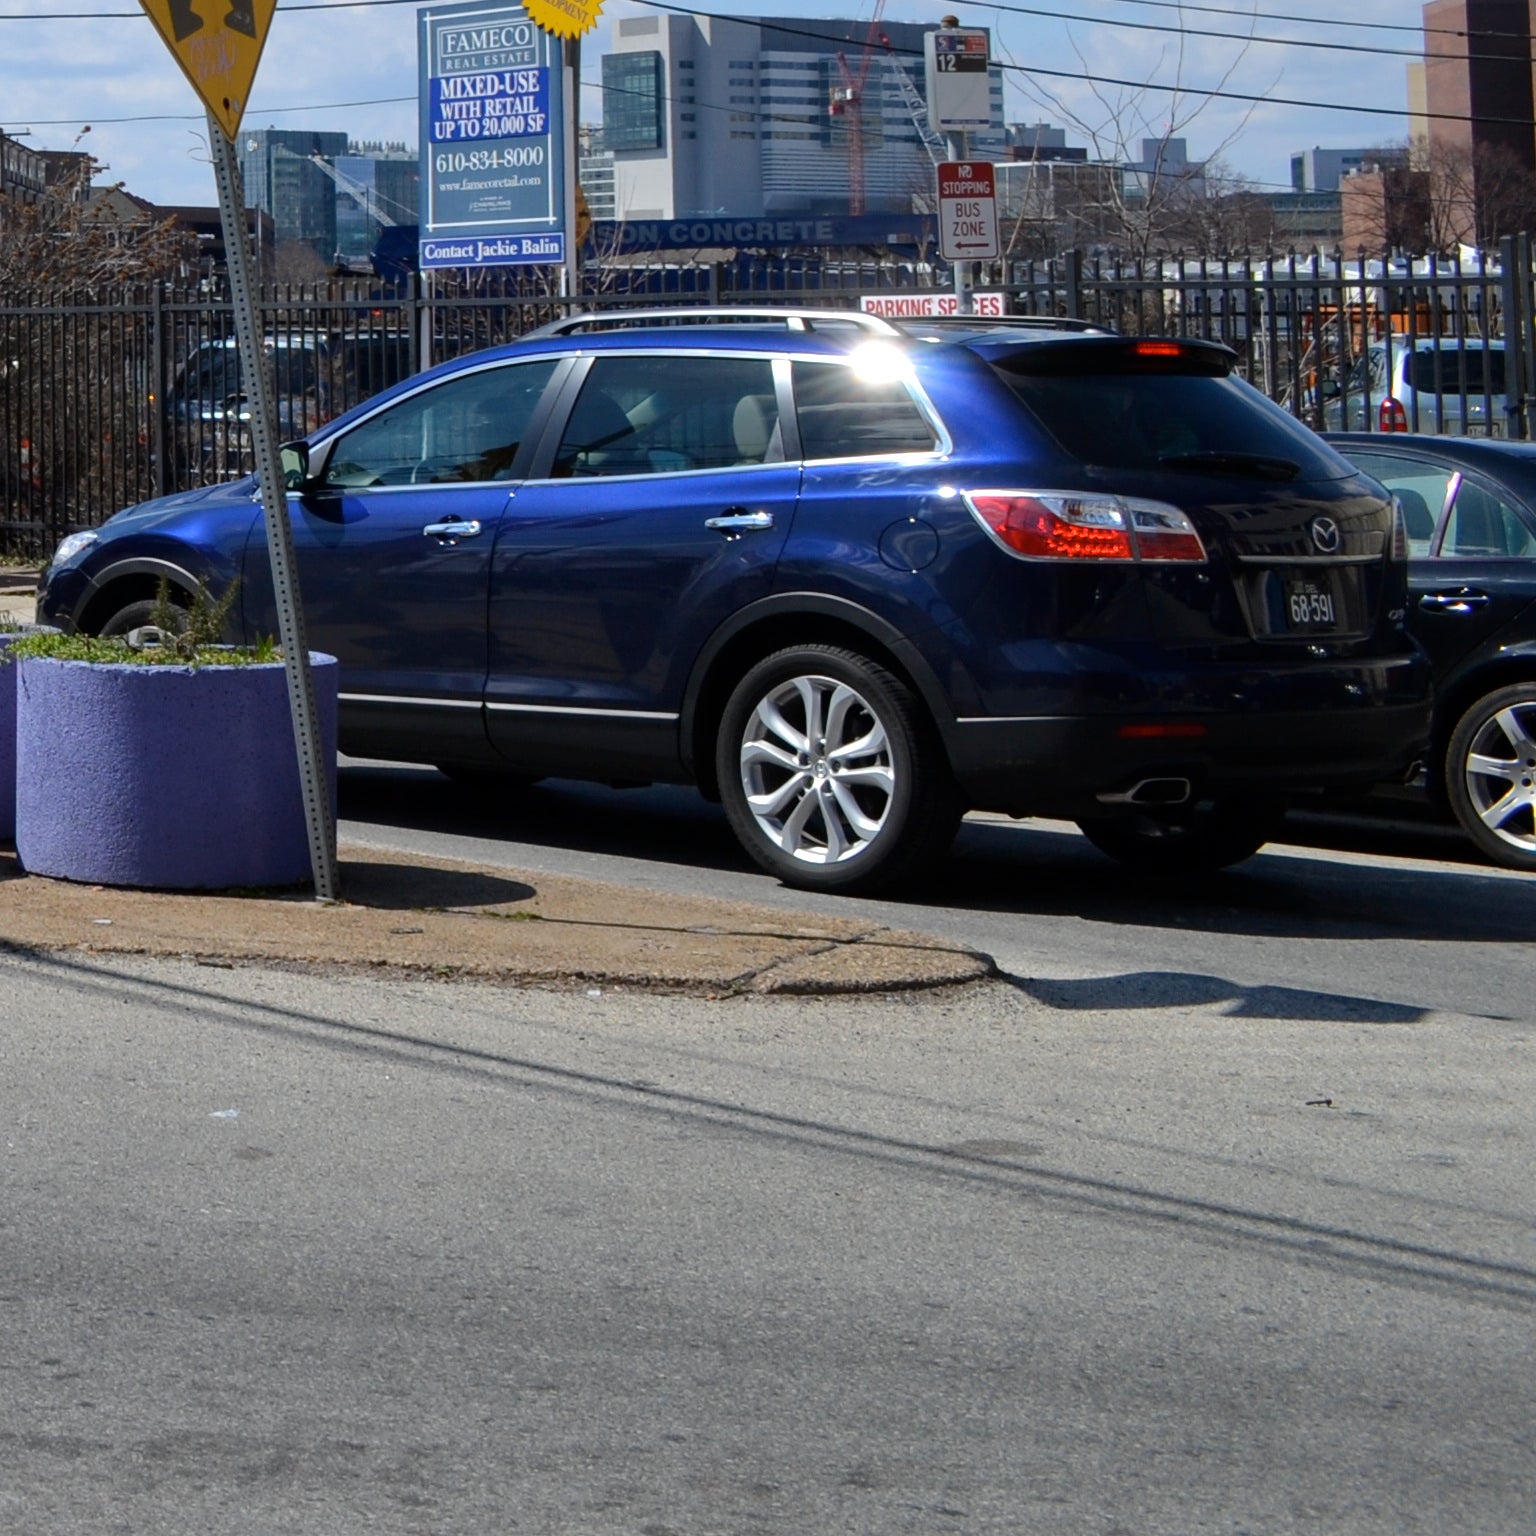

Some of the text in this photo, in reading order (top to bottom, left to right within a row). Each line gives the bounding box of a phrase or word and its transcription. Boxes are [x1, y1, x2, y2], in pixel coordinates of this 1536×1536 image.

[446, 25, 529, 54] FAMECO
[446, 51, 532, 70] REAL ESTATE
[938, 54, 957, 71] 12
[440, 70, 540, 101] MIXED-USE
[440, 96, 540, 121] WITH RETAIL
[434, 113, 546, 140] UP TO 20,000 SF
[436, 146, 544, 173] 610-834-8000
[958, 165, 973, 179] NO
[439, 174, 541, 192] www.famecoretail.com
[943, 181, 991, 195] STOPPING
[955, 202, 981, 218] BUS
[669, 220, 834, 243] CONCRETE
[952, 221, 986, 236] ZONE
[425, 238, 560, 262] Contact Jackie Balin
[866, 297, 1000, 316] PARKING SPCES
